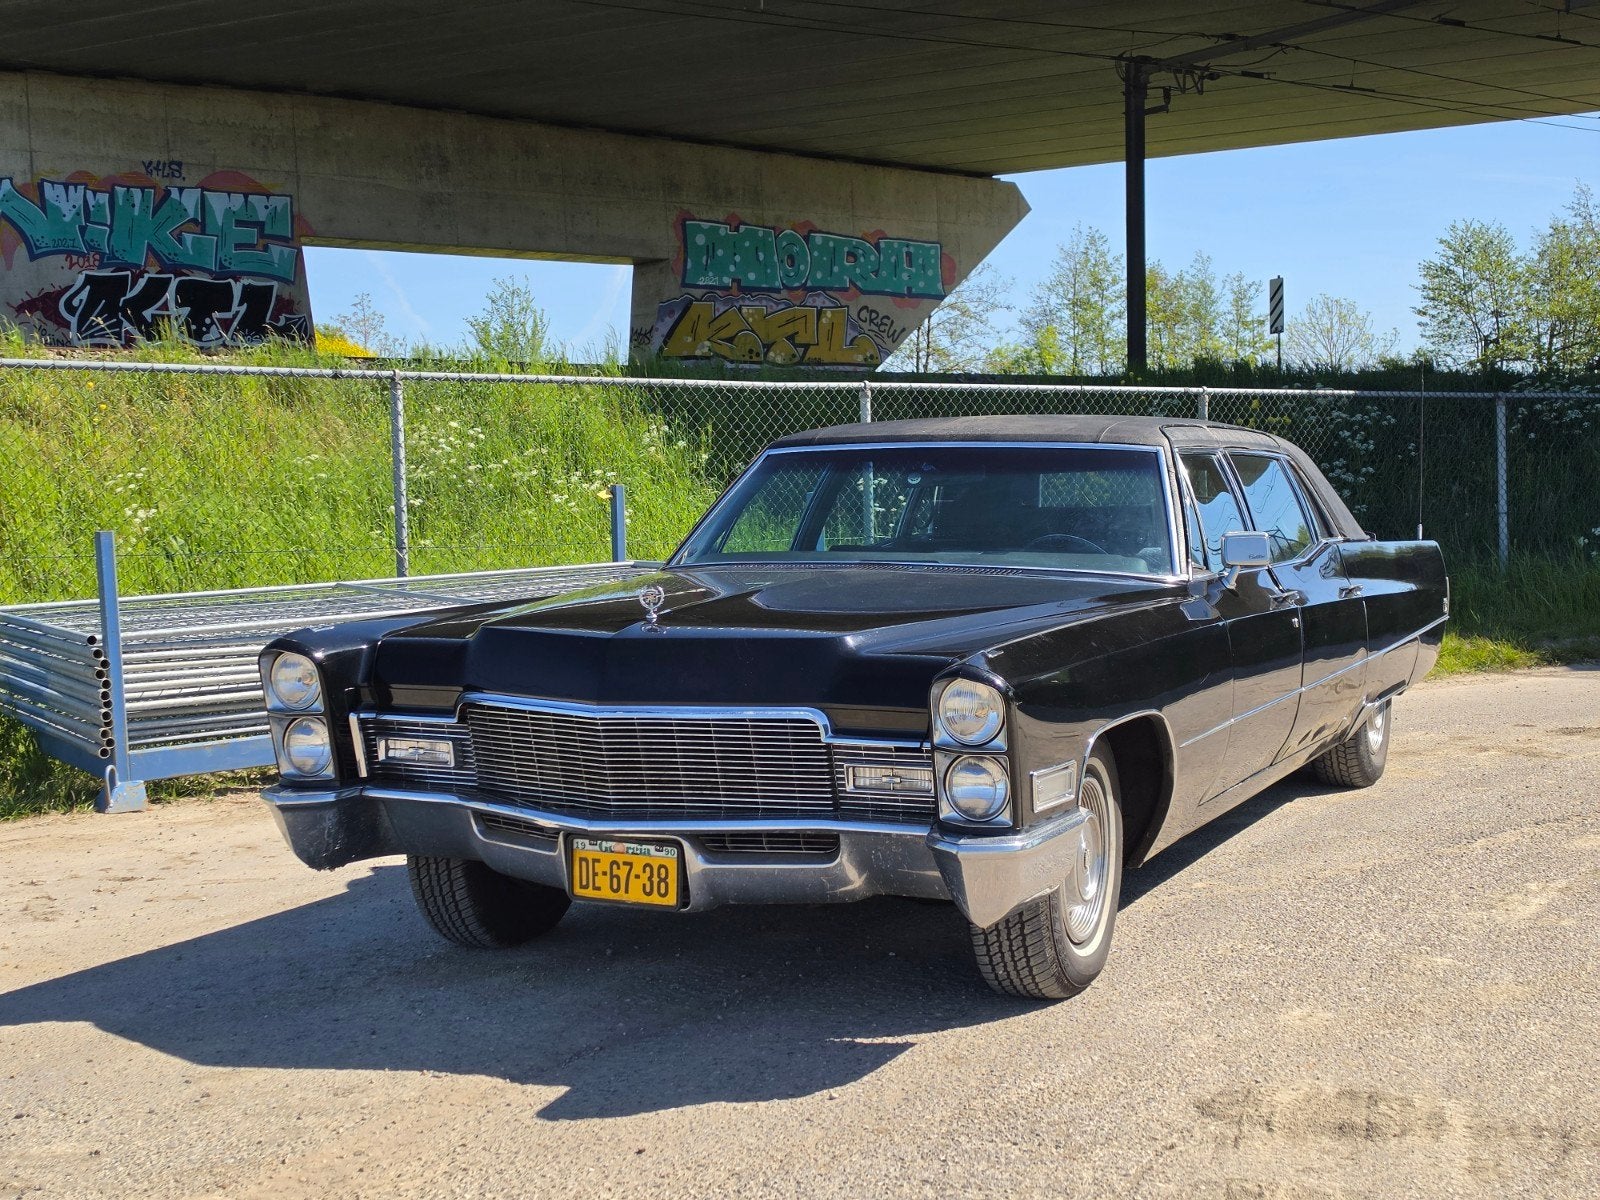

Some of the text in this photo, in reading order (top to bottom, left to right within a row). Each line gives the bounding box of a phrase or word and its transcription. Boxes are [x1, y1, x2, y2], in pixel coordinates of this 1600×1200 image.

[856, 304, 907, 344] CREW
[575, 841, 586, 850] 19
[664, 848, 676, 857] 90
[578, 856, 670, 899] DE-67-38
